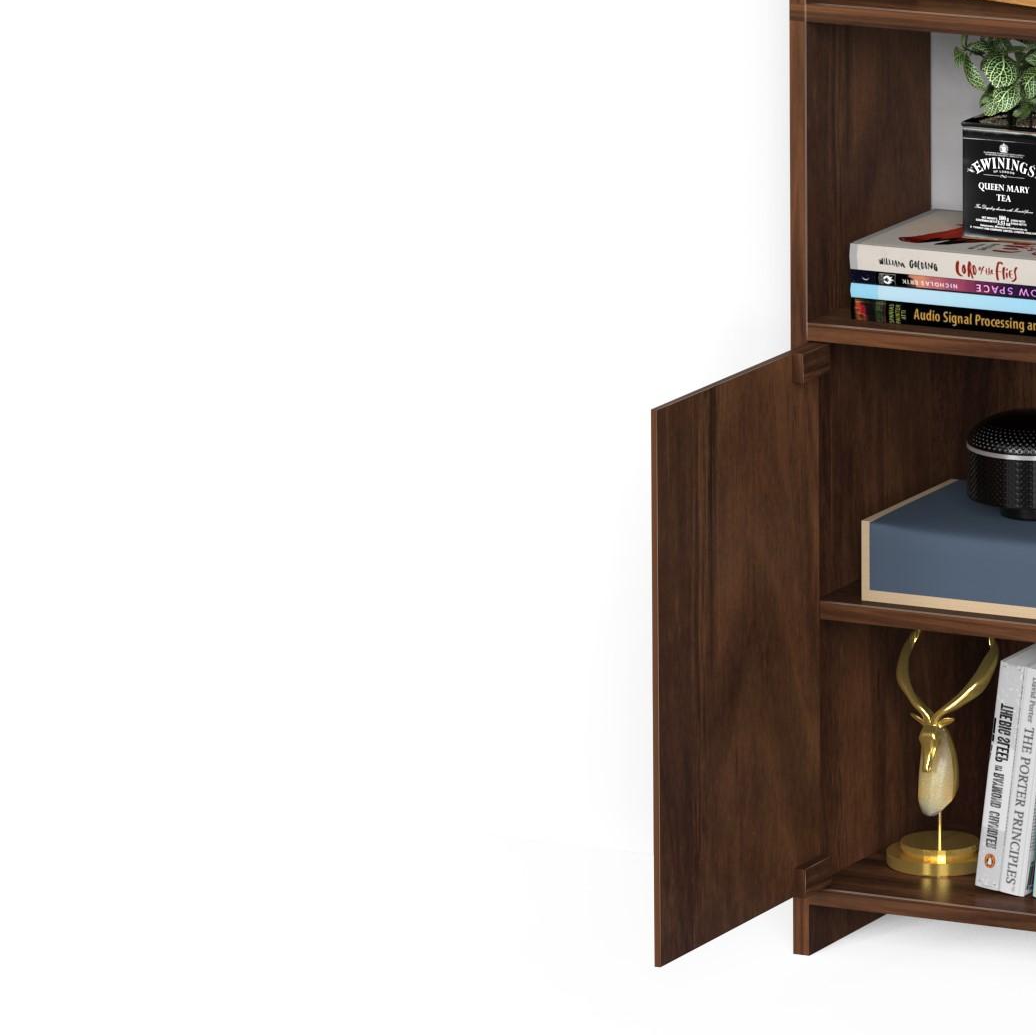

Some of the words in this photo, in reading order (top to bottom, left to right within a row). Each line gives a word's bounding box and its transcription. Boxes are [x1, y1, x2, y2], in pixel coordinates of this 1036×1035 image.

[978, 181, 1004, 192] QUEEN
[1006, 185, 1030, 194] MARY
[996, 194, 1011, 203] TEA
[909, 259, 938, 272] GOLDING
[920, 279, 958, 289] NICHOLAS
[975, 283, 1013, 297] SPACE
[913, 307, 940, 323] Audio
[943, 310, 973, 329] Signal
[975, 313, 1025, 333] Processing
[1026, 700, 1036, 724] Porter
[1021, 727, 1035, 754] THE
[1015, 756, 1031, 808] PORTER
[1005, 809, 1025, 885] PRINCIPLES
